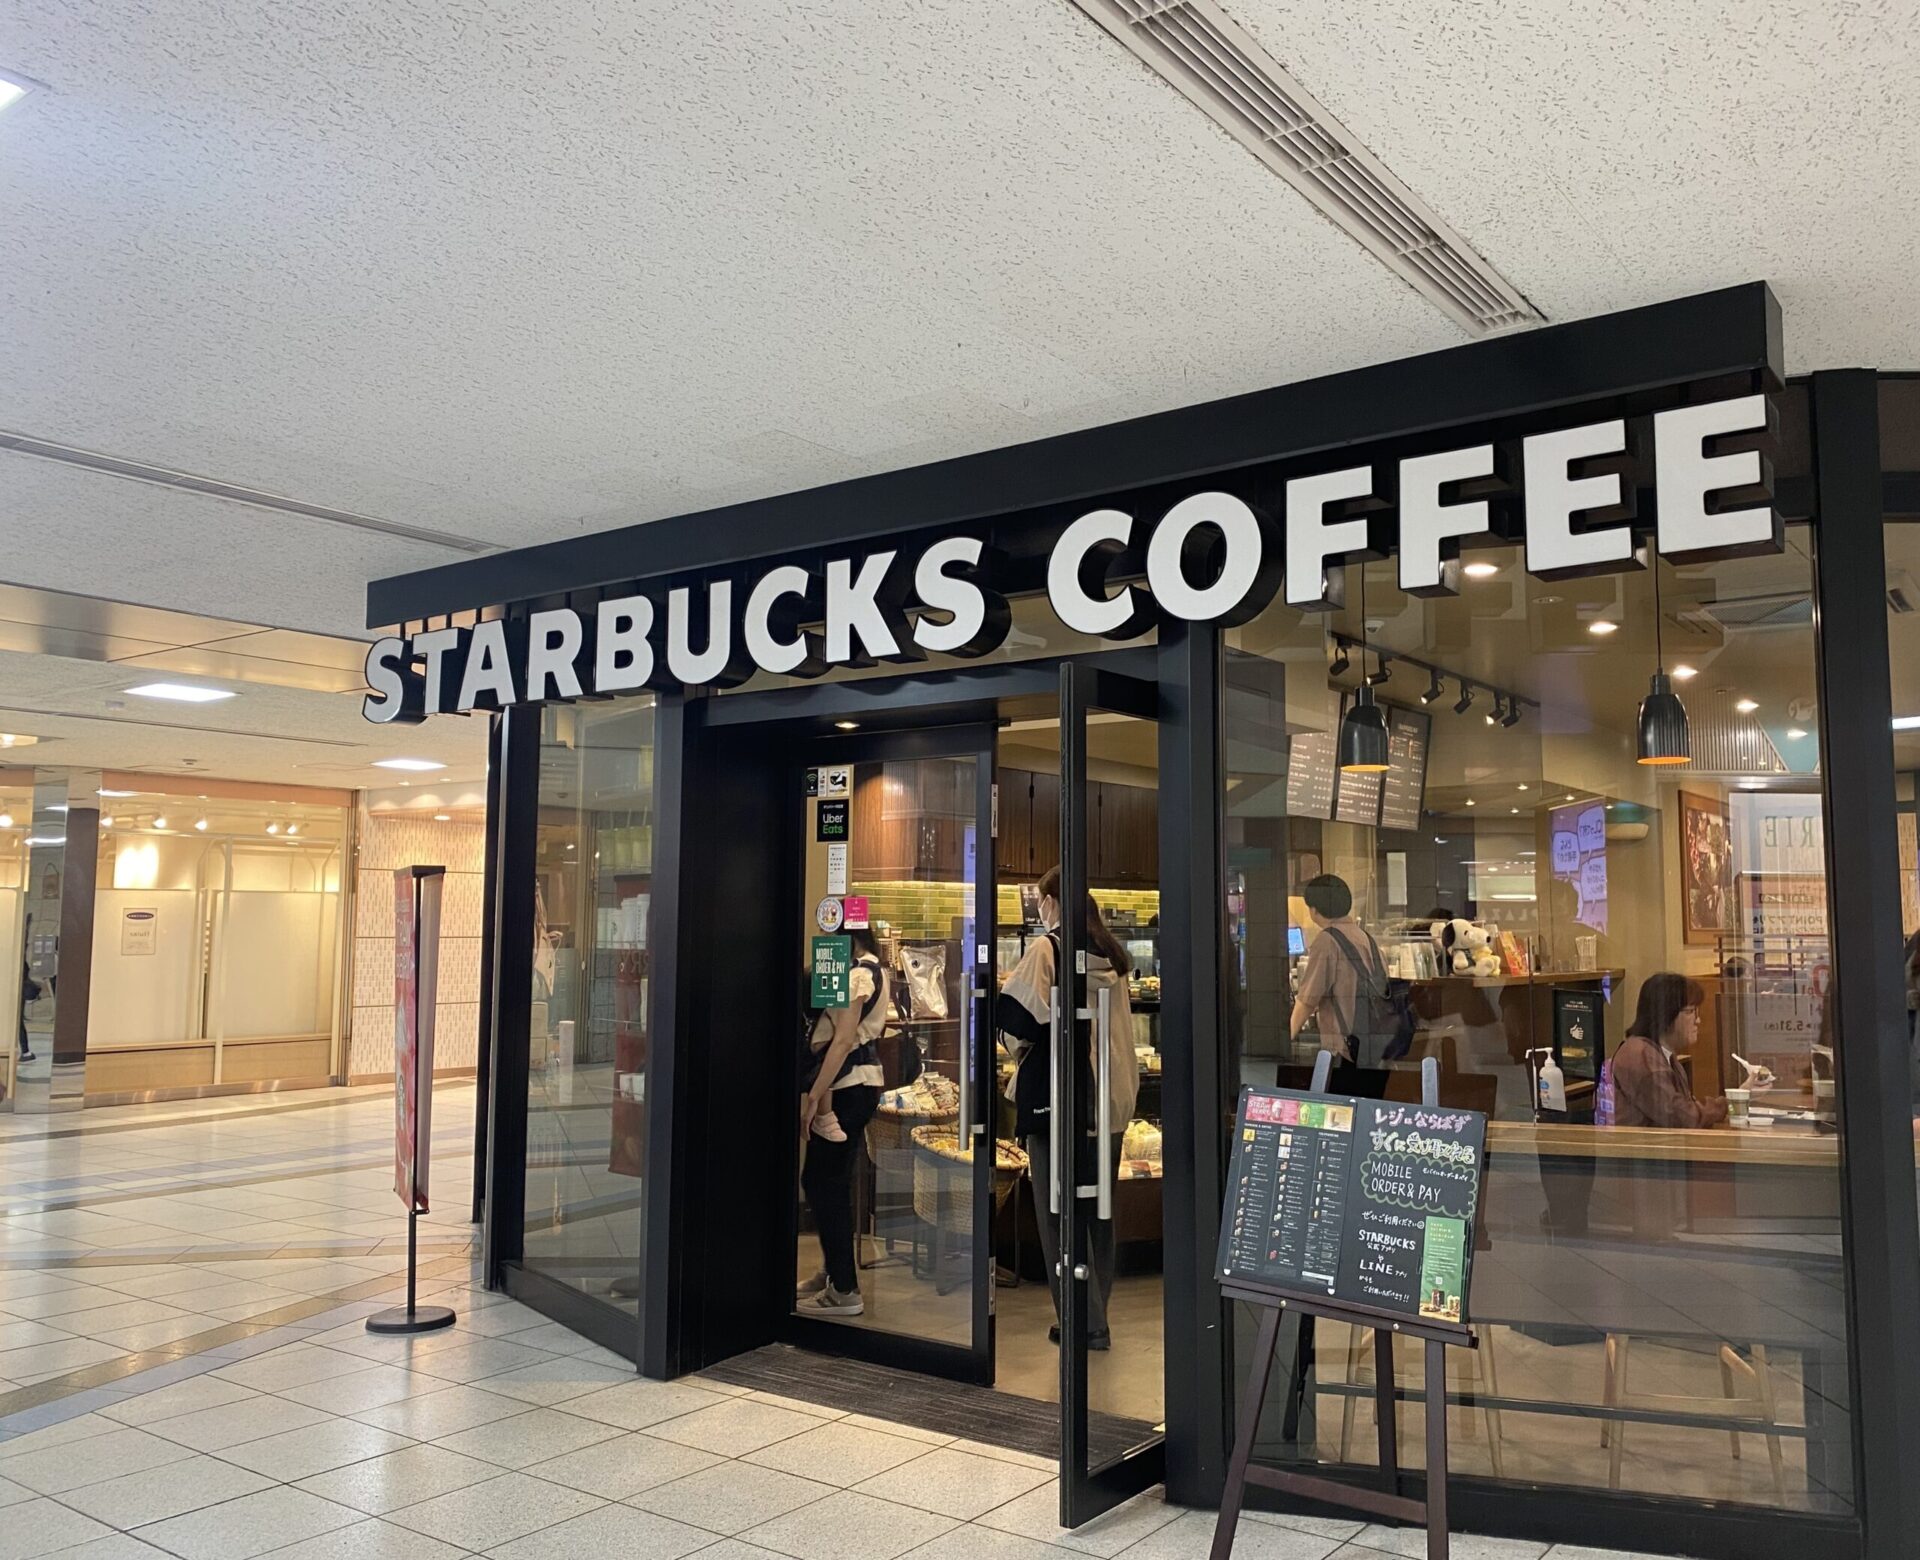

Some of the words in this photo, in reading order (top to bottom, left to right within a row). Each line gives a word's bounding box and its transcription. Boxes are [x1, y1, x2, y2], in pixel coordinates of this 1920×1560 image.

[362, 537, 985, 723] STARBUCKS
[1047, 394, 1773, 634] COFFEE
[823, 813, 844, 823] Uber
[823, 824, 843, 834] Eats
[816, 948, 833, 960] MOBILE
[816, 962, 831, 974] ORDER
[836, 961, 846, 974] PAY
[1375, 1107, 1472, 1133] レジにならばず
[1369, 1128, 1475, 1164] すぐに受け取れる
[1371, 1161, 1412, 1179] MOBILE
[1418, 1184, 1441, 1203] PAY
[1358, 1229, 1416, 1250] STARBUCKS
[1359, 1259, 1394, 1275] LINE
